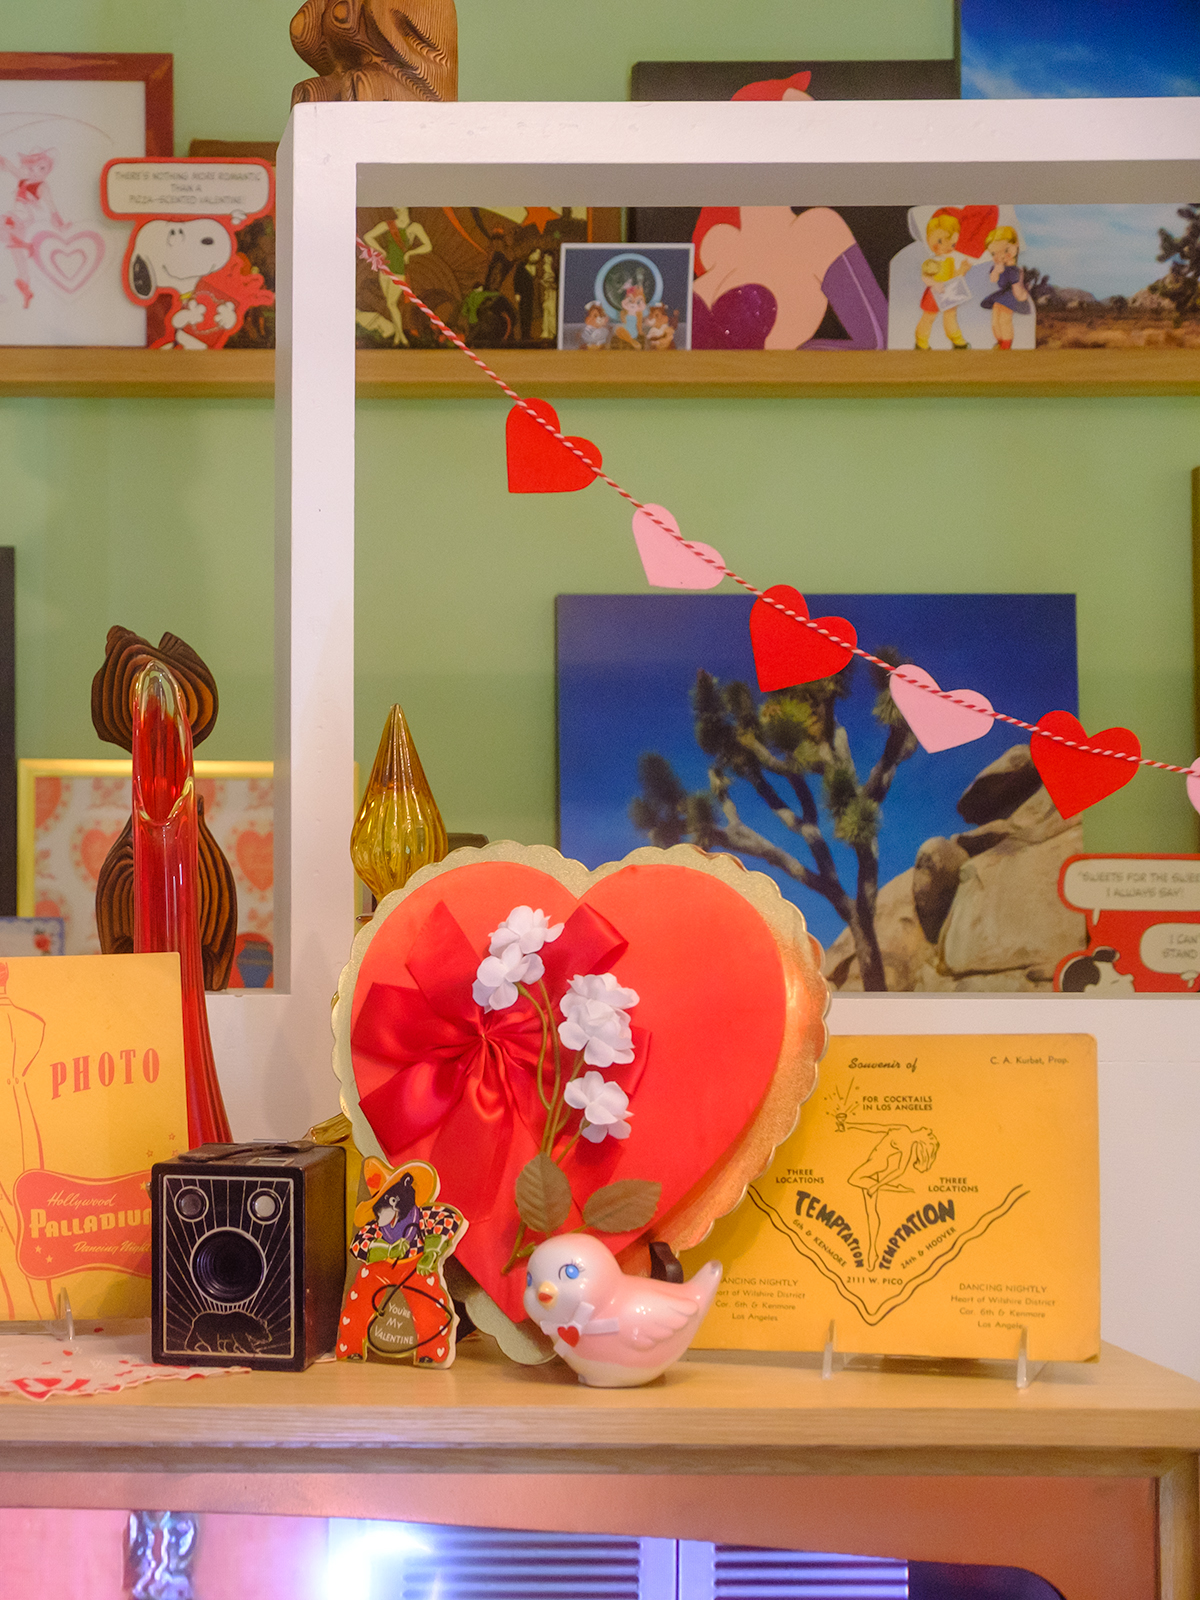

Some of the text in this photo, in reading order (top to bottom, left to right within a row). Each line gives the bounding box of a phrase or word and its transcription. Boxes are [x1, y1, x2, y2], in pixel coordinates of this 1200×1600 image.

[152, 171, 189, 181] NOTHING
[192, 171, 215, 181] MORE
[218, 171, 262, 181] ROMANTIC
[170, 183, 202, 192] THAN A
[1127, 871, 1147, 882] FOR
[1150, 871, 1168, 882] THE
[1171, 871, 1200, 882] SWEE
[1113, 888, 1156, 897] ALWAYS
[1162, 948, 1198, 959] STAND
[848, 1057, 918, 1073] Souvenir of
[990, 1056, 999, 1065] C.
[50, 1048, 160, 1100] PHOTO
[928, 1185, 979, 1193] LOCATIONS
[47, 1190, 118, 1210] Hollywood
[795, 1190, 864, 1269] TEMPTATION
[879, 1199, 956, 1270] TEMPTATION
[73, 1241, 119, 1255] Dancing
[792, 1219, 805, 1232] 6th
[813, 1236, 848, 1268] KENMORE
[900, 1256, 917, 1270] 24th
[925, 1227, 957, 1251] HOOVER
[720, 1277, 799, 1287] ANCING NIGHTLY
[846, 1276, 904, 1286] 2111 W. PICO
[959, 1282, 1048, 1294] DANCING NIGHTLY
[742, 1290, 775, 1298] Wilshire
[777, 1290, 806, 1299] District
[762, 1302, 796, 1310] Kenmore
[950, 1295, 1056, 1307] Heart of Wilshire District
[747, 1313, 779, 1322] Angeles
[980, 1308, 994, 1316] 6th
[1009, 1309, 1046, 1319] Kenmore
[977, 1320, 1024, 1331] Los Angele
[374, 1325, 414, 1345] VALENTINE
